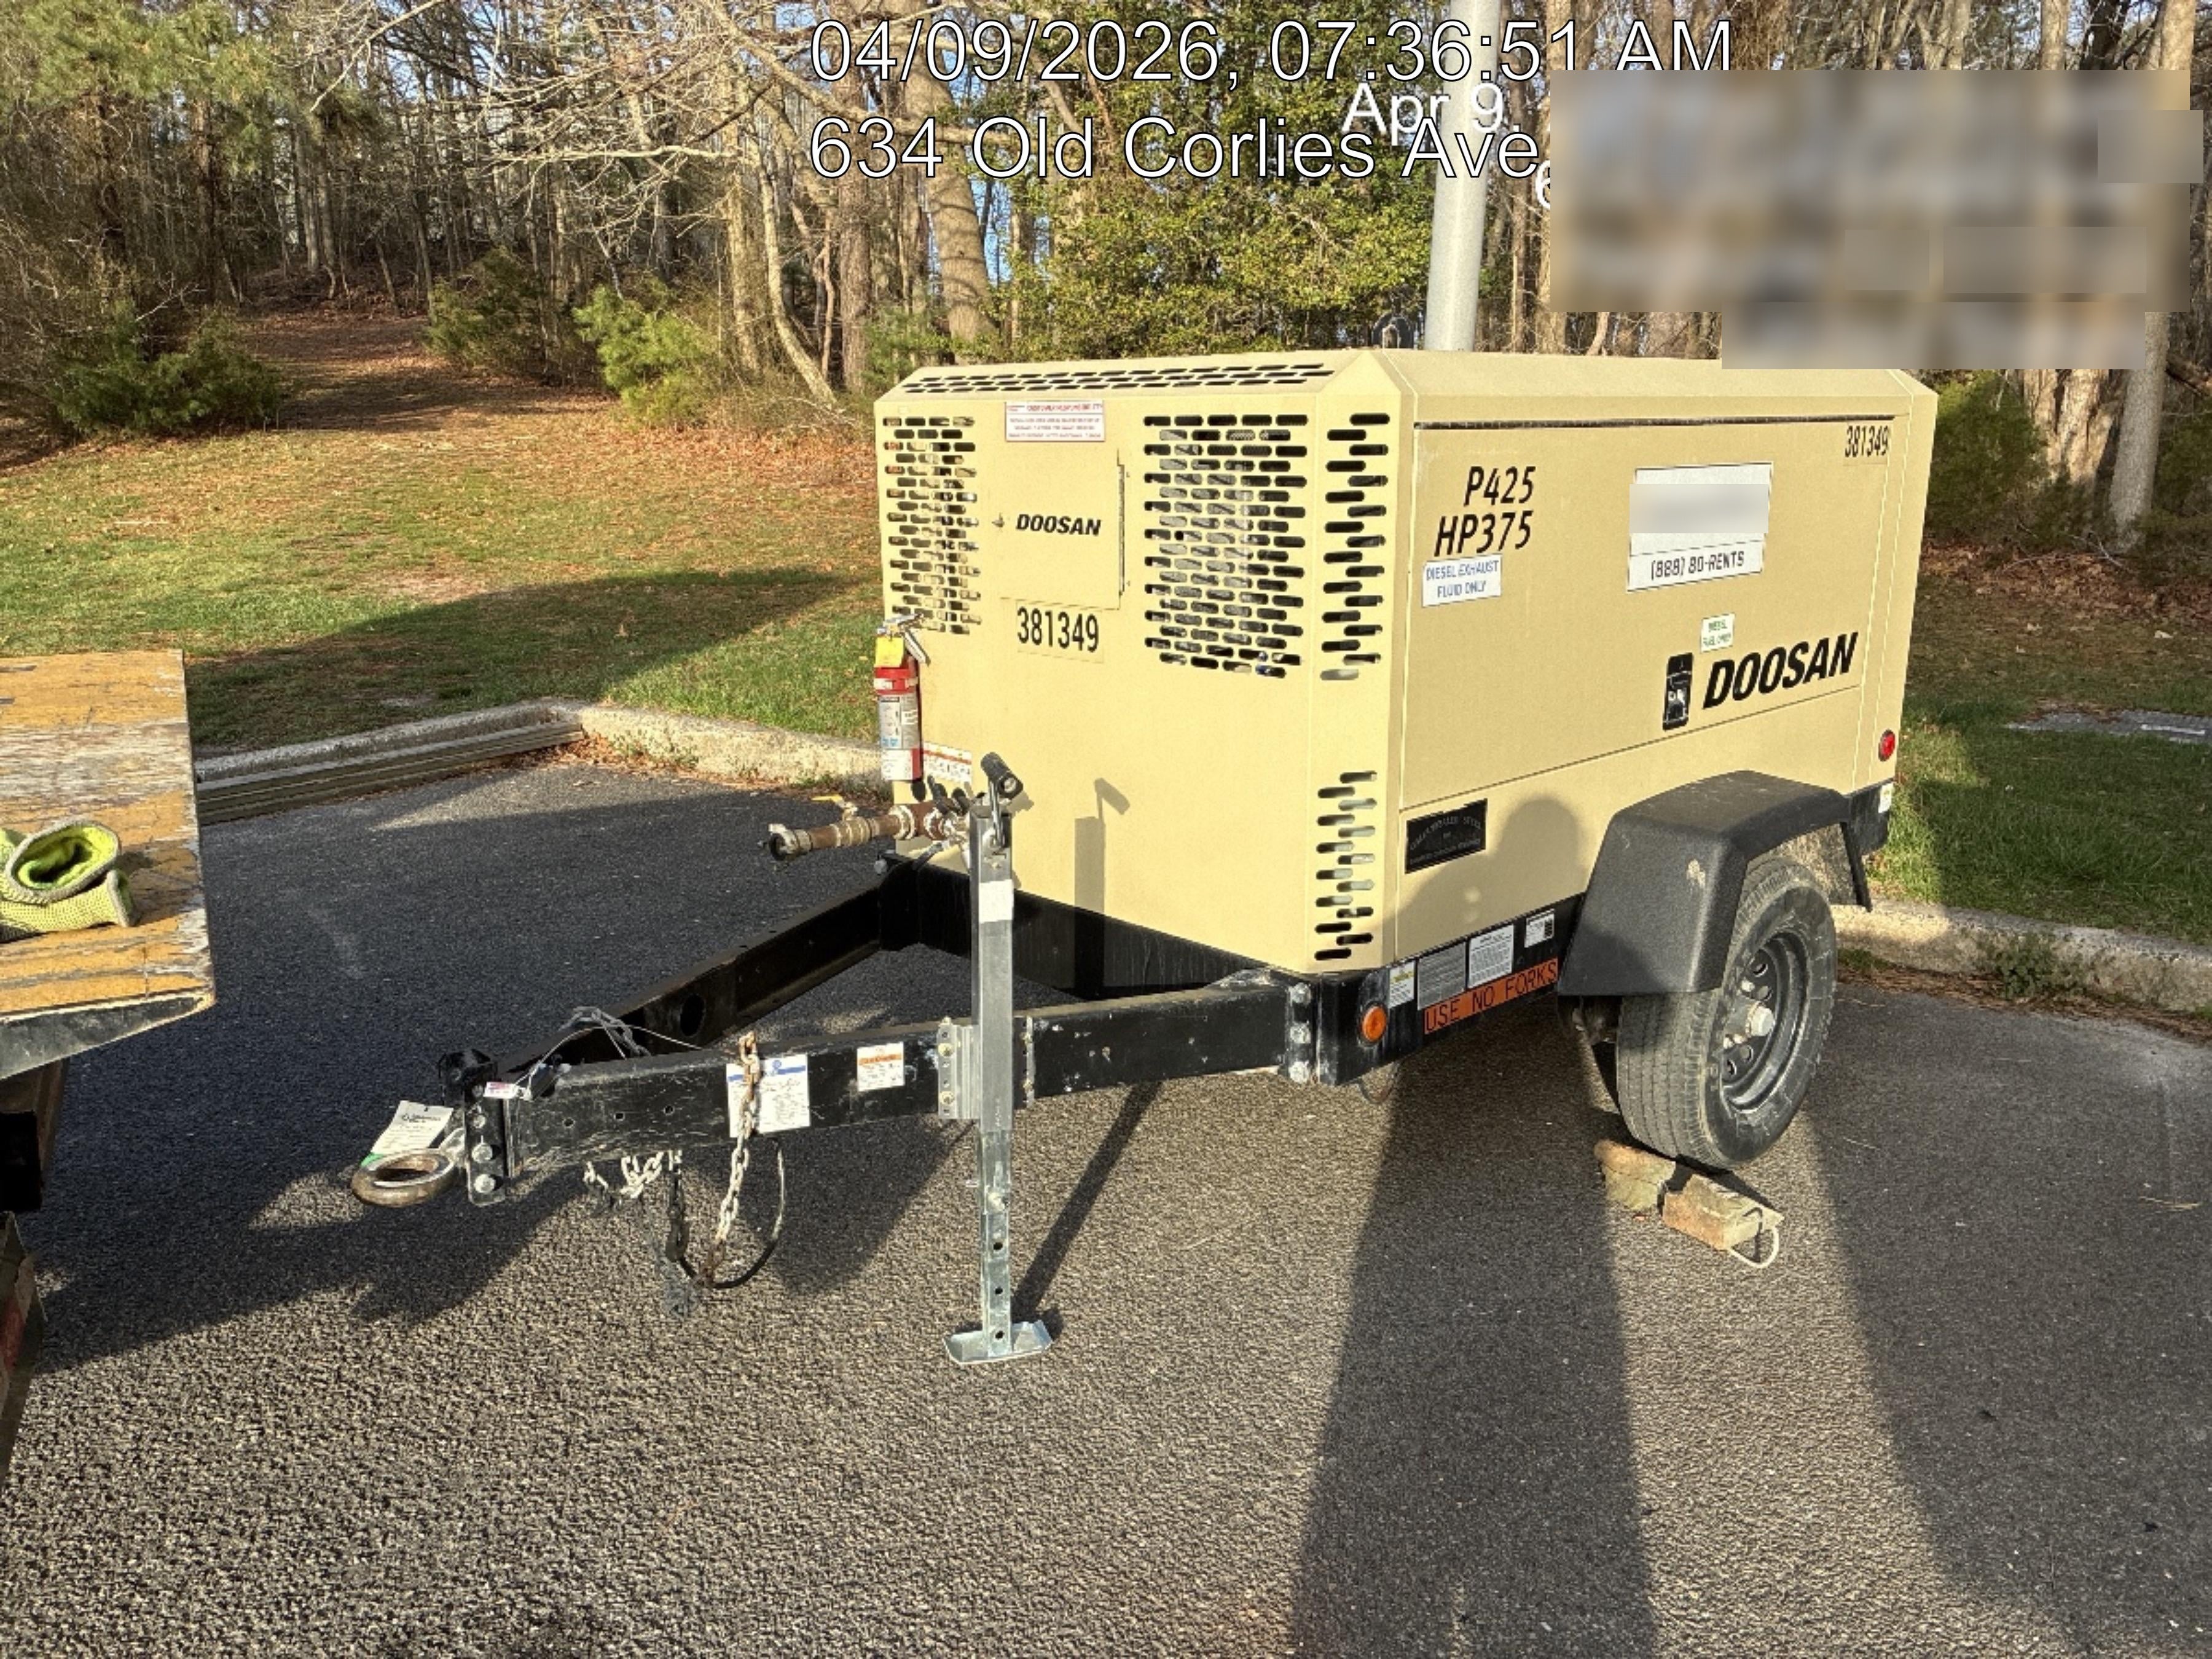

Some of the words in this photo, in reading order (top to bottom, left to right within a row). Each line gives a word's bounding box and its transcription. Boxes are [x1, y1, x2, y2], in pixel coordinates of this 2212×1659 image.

[1845, 425, 1889, 458] 381349
[1464, 466, 1536, 507] P425
[1016, 514, 1102, 536] DOOSAN
[1433, 510, 1534, 557] HP375
[1426, 565, 1457, 581] DIESEL
[1457, 560, 1500, 577] EXHAUST
[1650, 556, 1685, 581] (888)
[1437, 584, 1462, 598] FLUID
[1017, 606, 1099, 653] 381349
[1701, 631, 1859, 710] DOOSAN
[1426, 998, 1461, 1032] USE
[1472, 986, 1495, 1013] NO
[1505, 961, 1557, 999] FORKS
